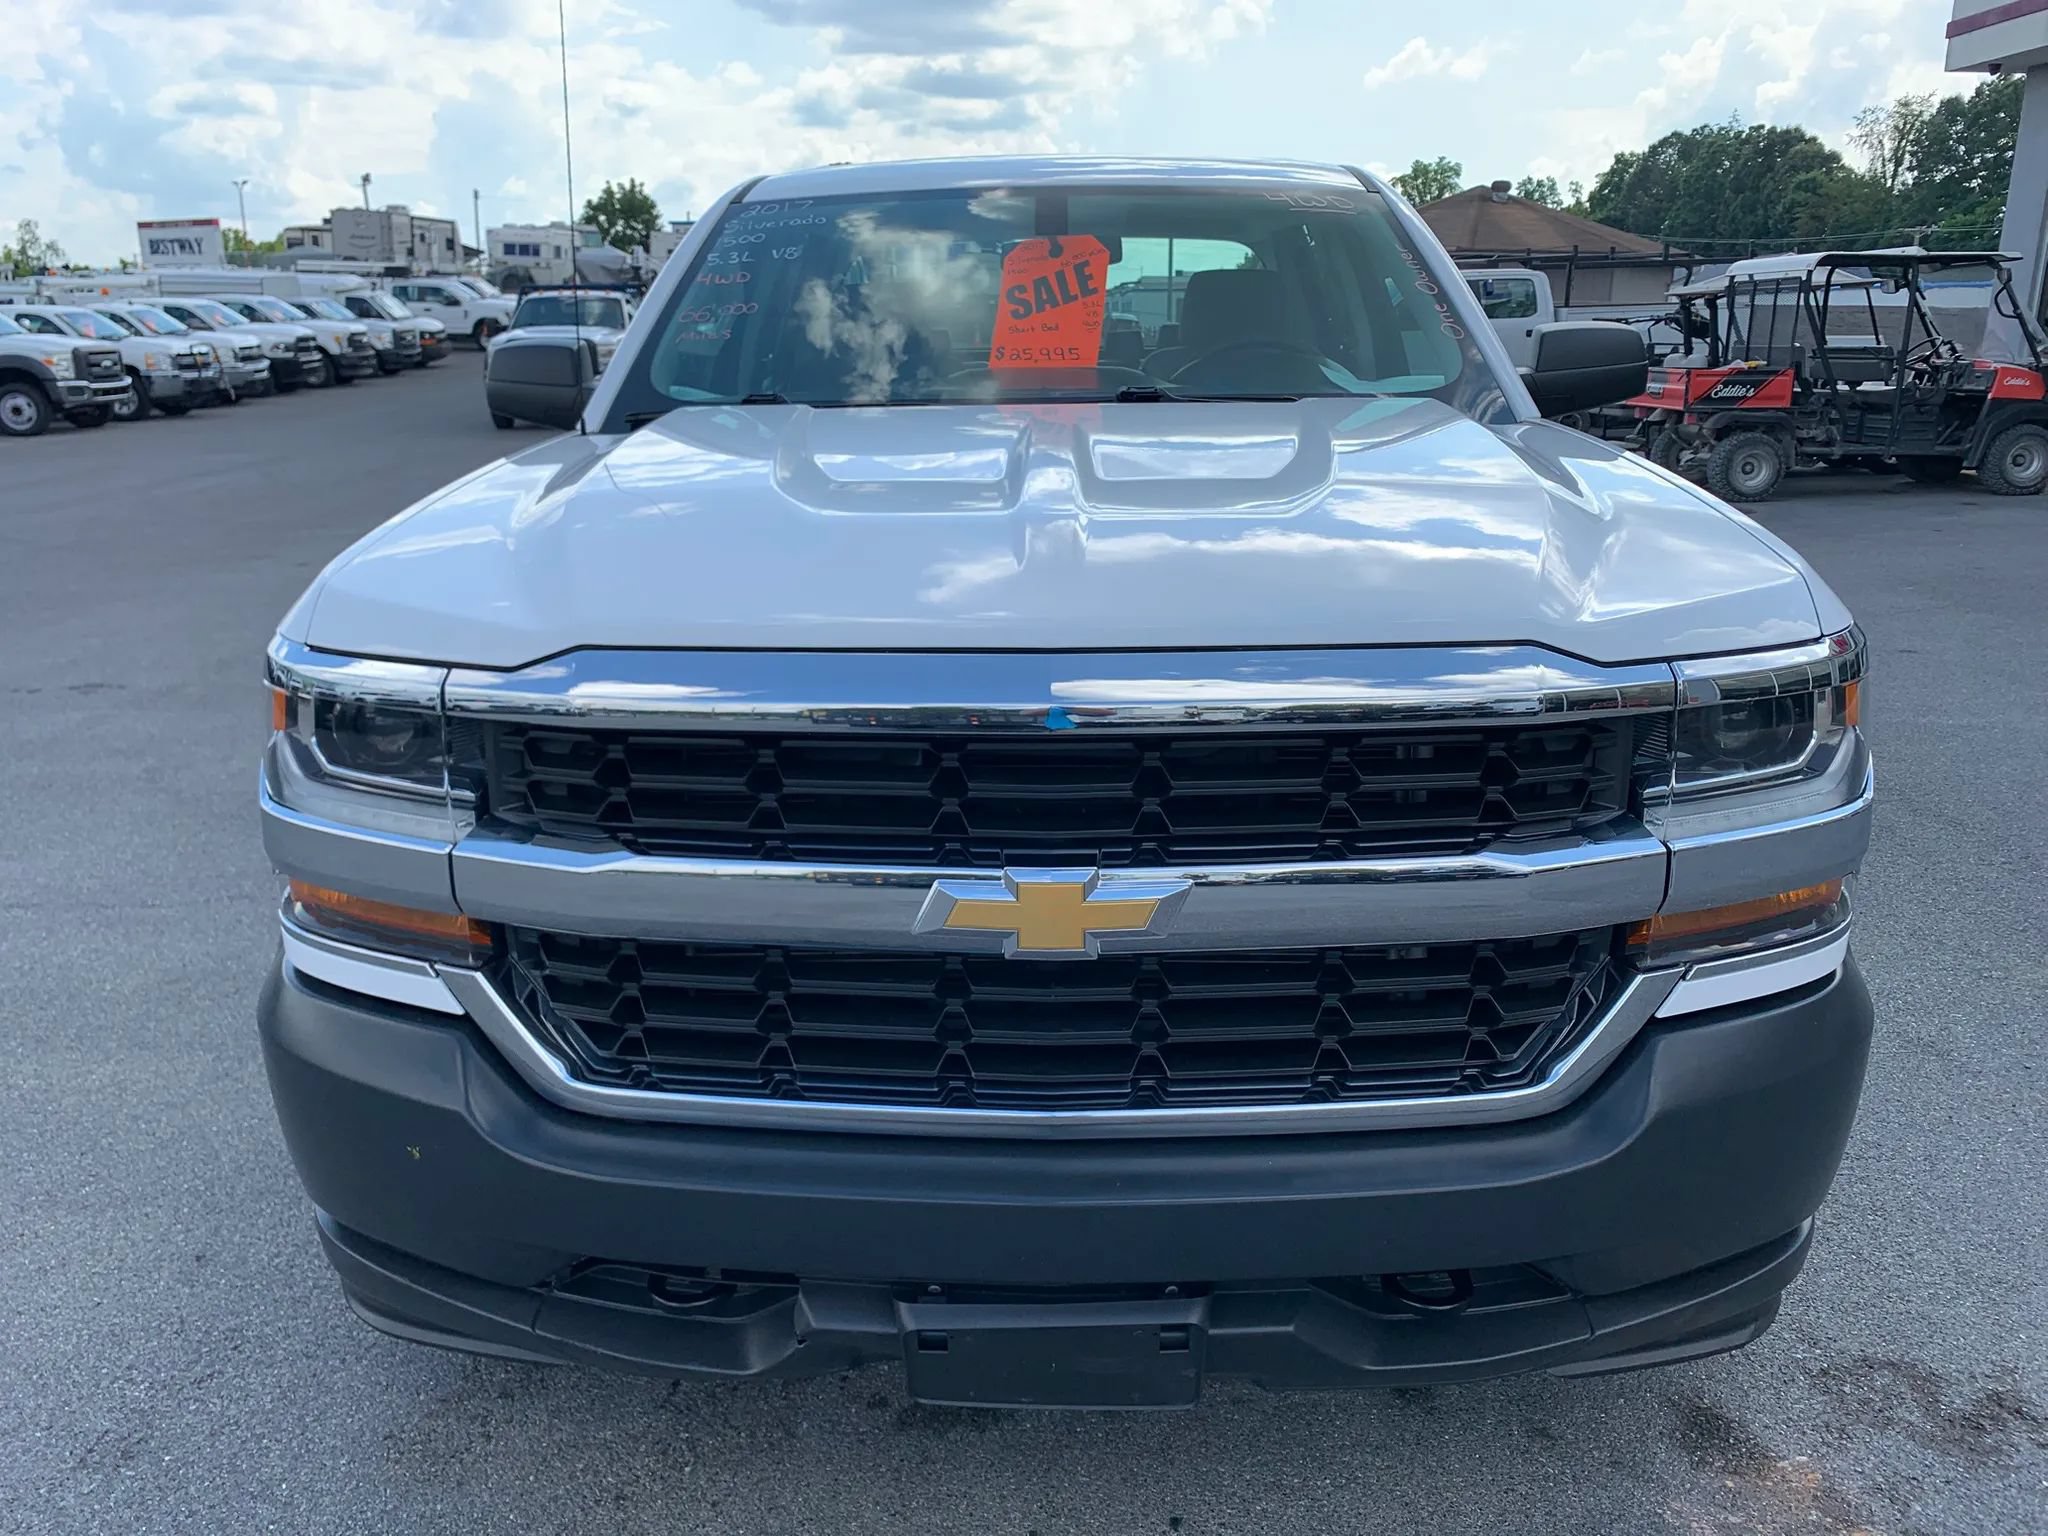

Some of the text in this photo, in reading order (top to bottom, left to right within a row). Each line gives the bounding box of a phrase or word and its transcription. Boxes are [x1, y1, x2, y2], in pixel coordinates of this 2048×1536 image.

[740, 200, 814, 218] 2017
[1263, 191, 1354, 209] 4WD
[724, 214, 827, 234] Silverado
[149, 238, 203, 255] BESTWAY
[715, 233, 766, 248] 1500
[707, 247, 799, 266] 5.3L V8
[697, 272, 751, 285] 4WD
[1005, 259, 1098, 320] SALE
[1394, 243, 1465, 339] One Owner
[679, 303, 759, 324] 66,000
[1009, 323, 1059, 334] Short Bed
[1711, 384, 1755, 398] Eddie's
